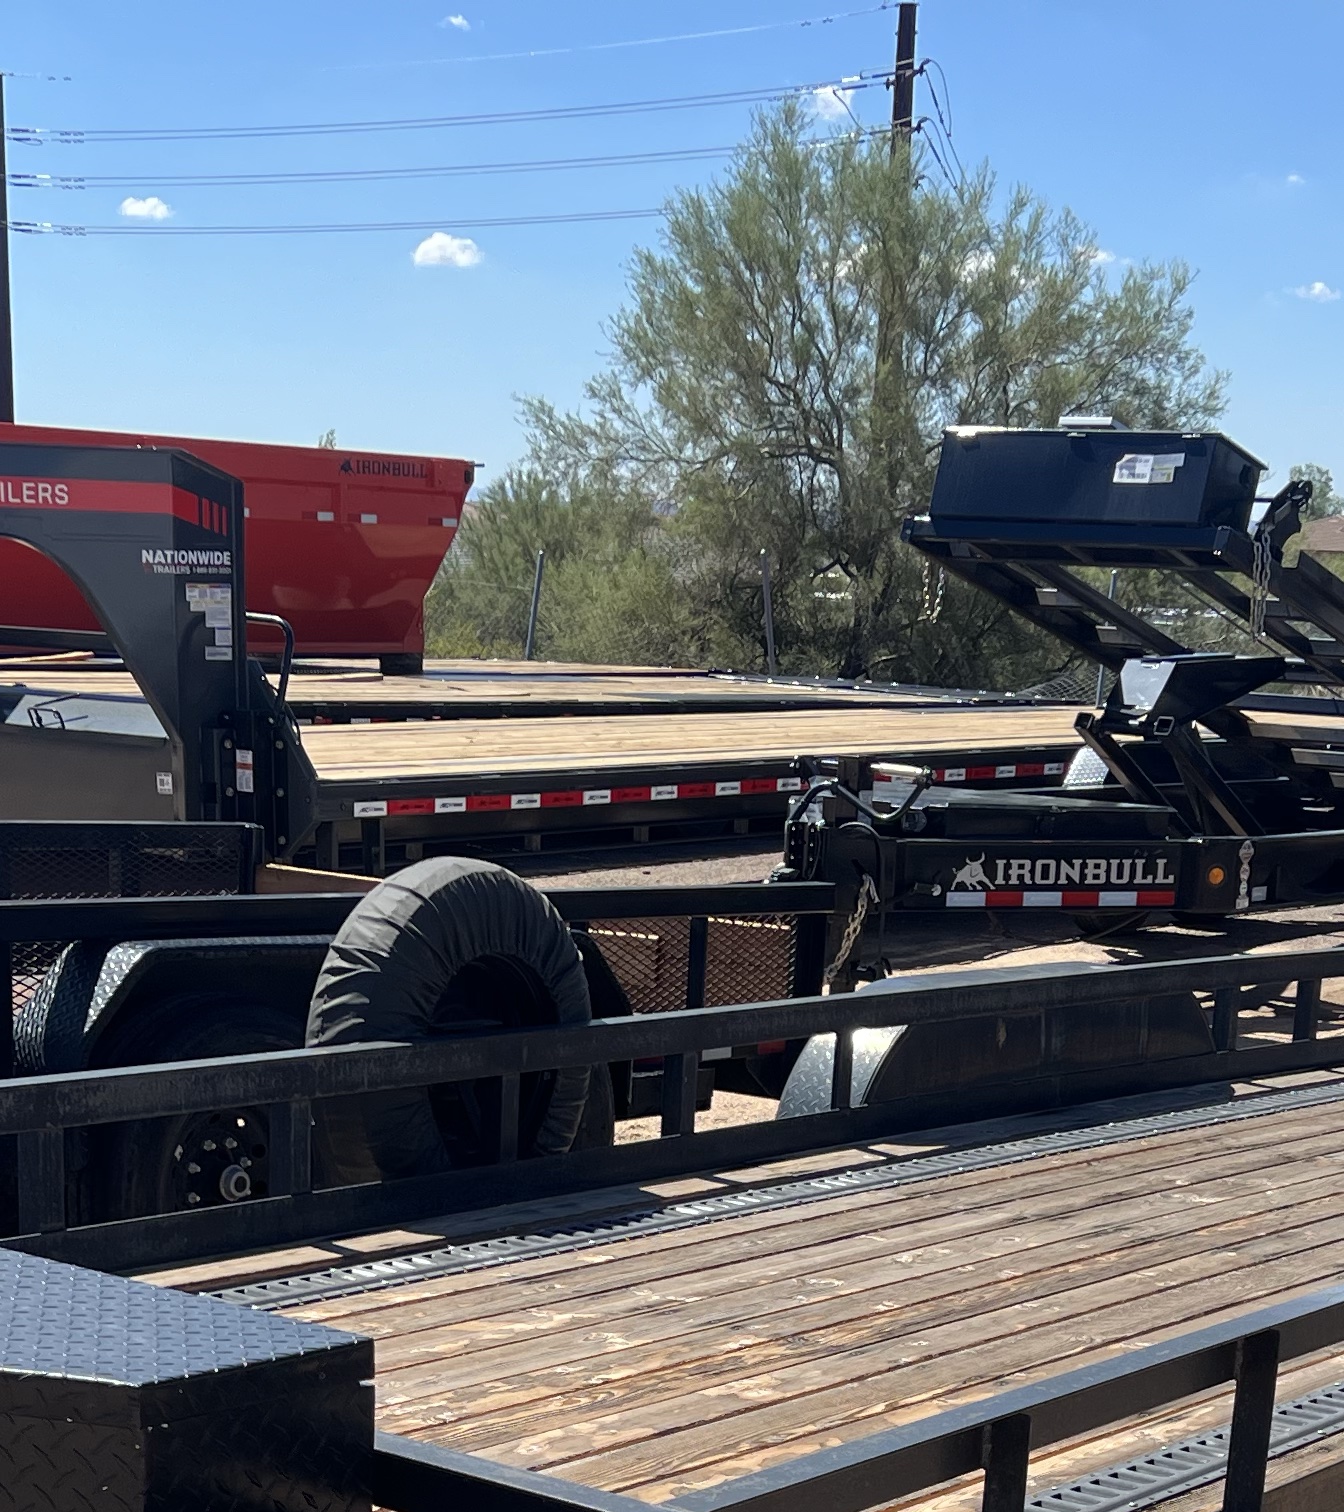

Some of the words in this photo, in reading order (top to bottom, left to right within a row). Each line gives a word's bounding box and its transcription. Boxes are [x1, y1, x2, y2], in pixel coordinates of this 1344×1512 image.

[355, 460, 429, 478] IRONBULL
[141, 549, 231, 566] NATIONWIDE
[153, 564, 190, 574] TRAILERS
[994, 858, 1175, 885] IRONBULL
